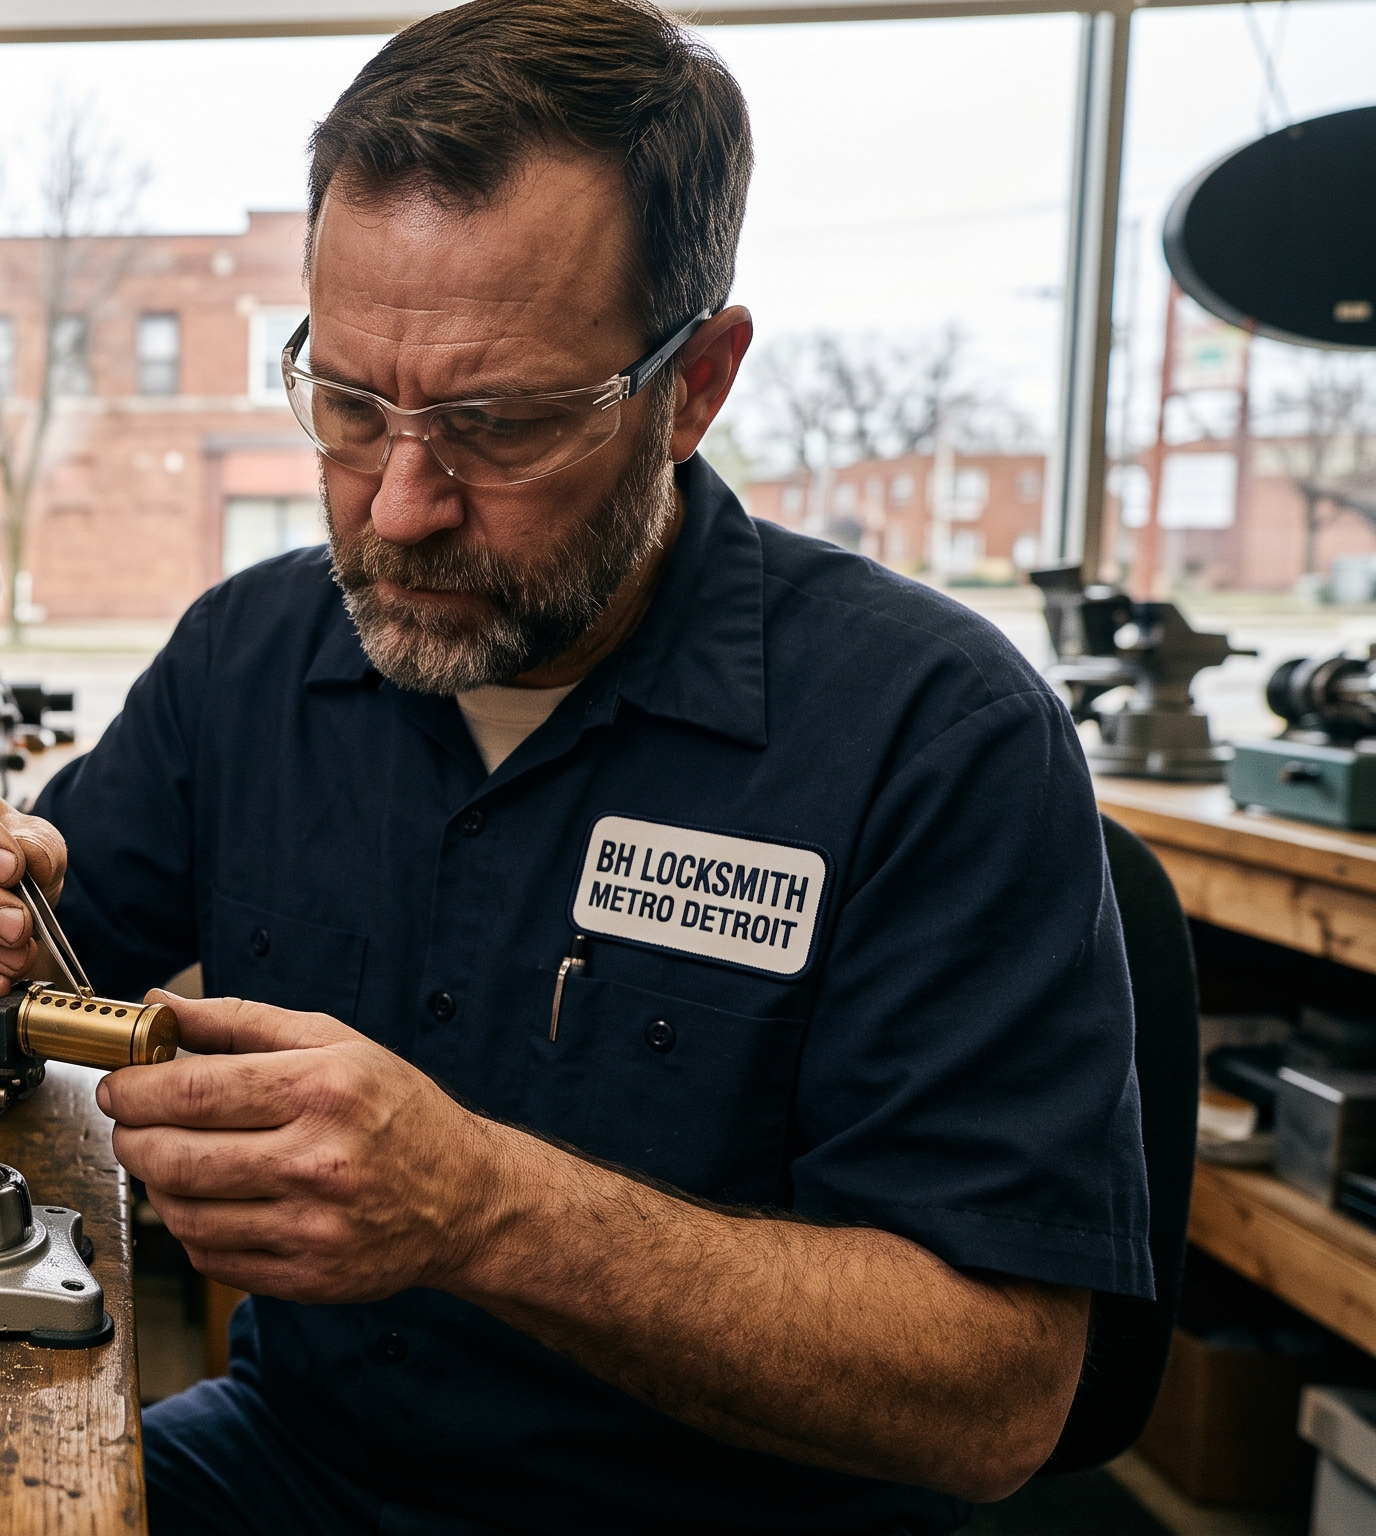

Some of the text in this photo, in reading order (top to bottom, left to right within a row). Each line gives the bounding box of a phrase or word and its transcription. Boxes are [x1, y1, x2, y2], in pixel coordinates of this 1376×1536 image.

[596, 839, 809, 913] BH LOCKSMITH
[588, 880, 798, 949] METRO DETROIT
